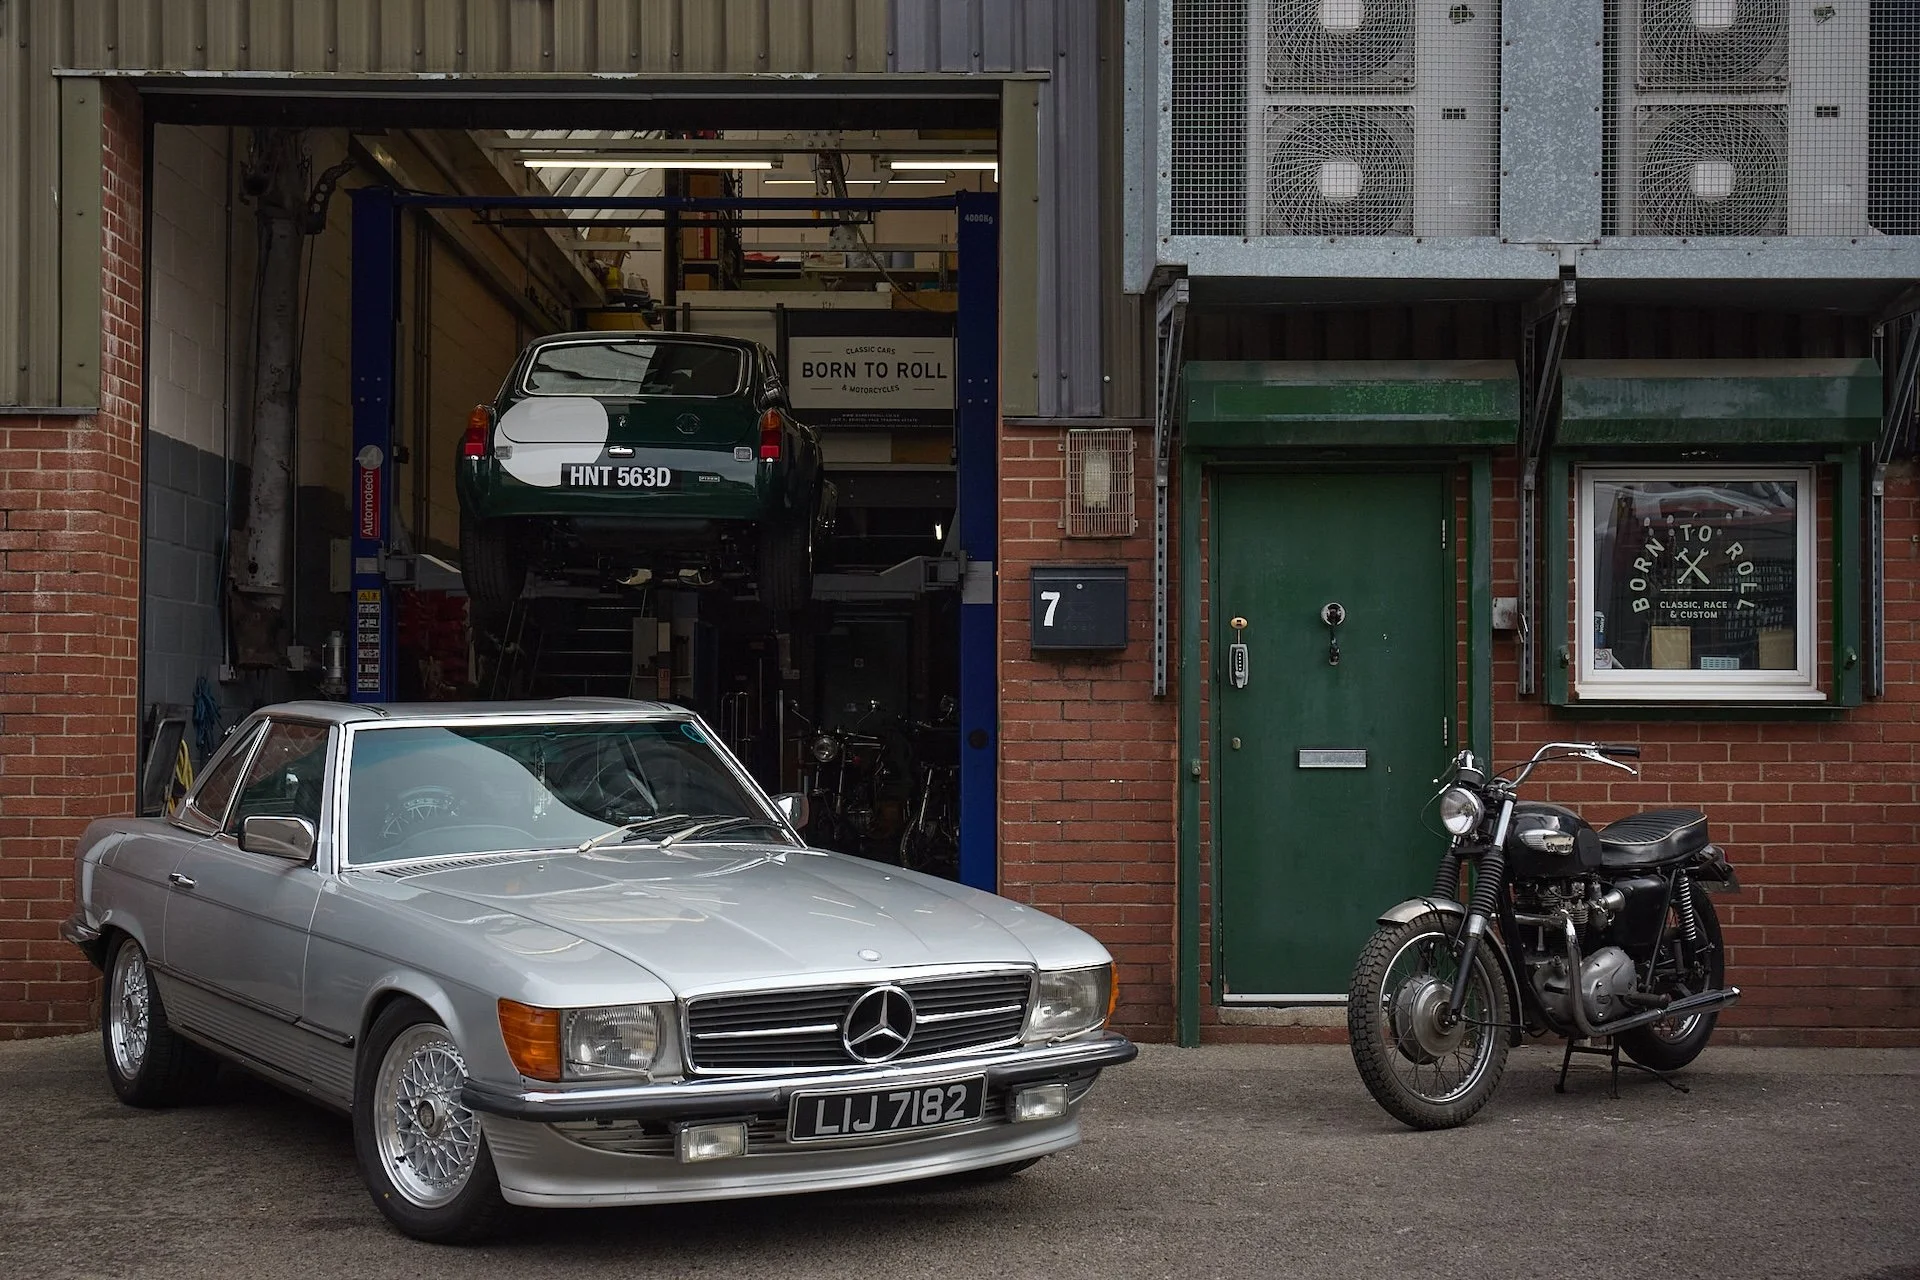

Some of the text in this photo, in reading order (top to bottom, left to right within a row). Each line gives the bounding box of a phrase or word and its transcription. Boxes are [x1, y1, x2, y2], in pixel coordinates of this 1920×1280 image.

[846, 346, 896, 355] CLASSIC CARS
[802, 362, 947, 379] BORN TO ROLL
[849, 384, 900, 393] MOTORCYCLES
[570, 465, 672, 487] HNT 563D
[362, 470, 374, 536] Automotech
[1630, 524, 1757, 613] BORN TO ROLL
[1041, 591, 1060, 626] 7
[1660, 601, 1728, 609] CLASSIC, RACE
[1670, 611, 1718, 619] & CUSTOM
[815, 1084, 967, 1135] LIJ 7182
